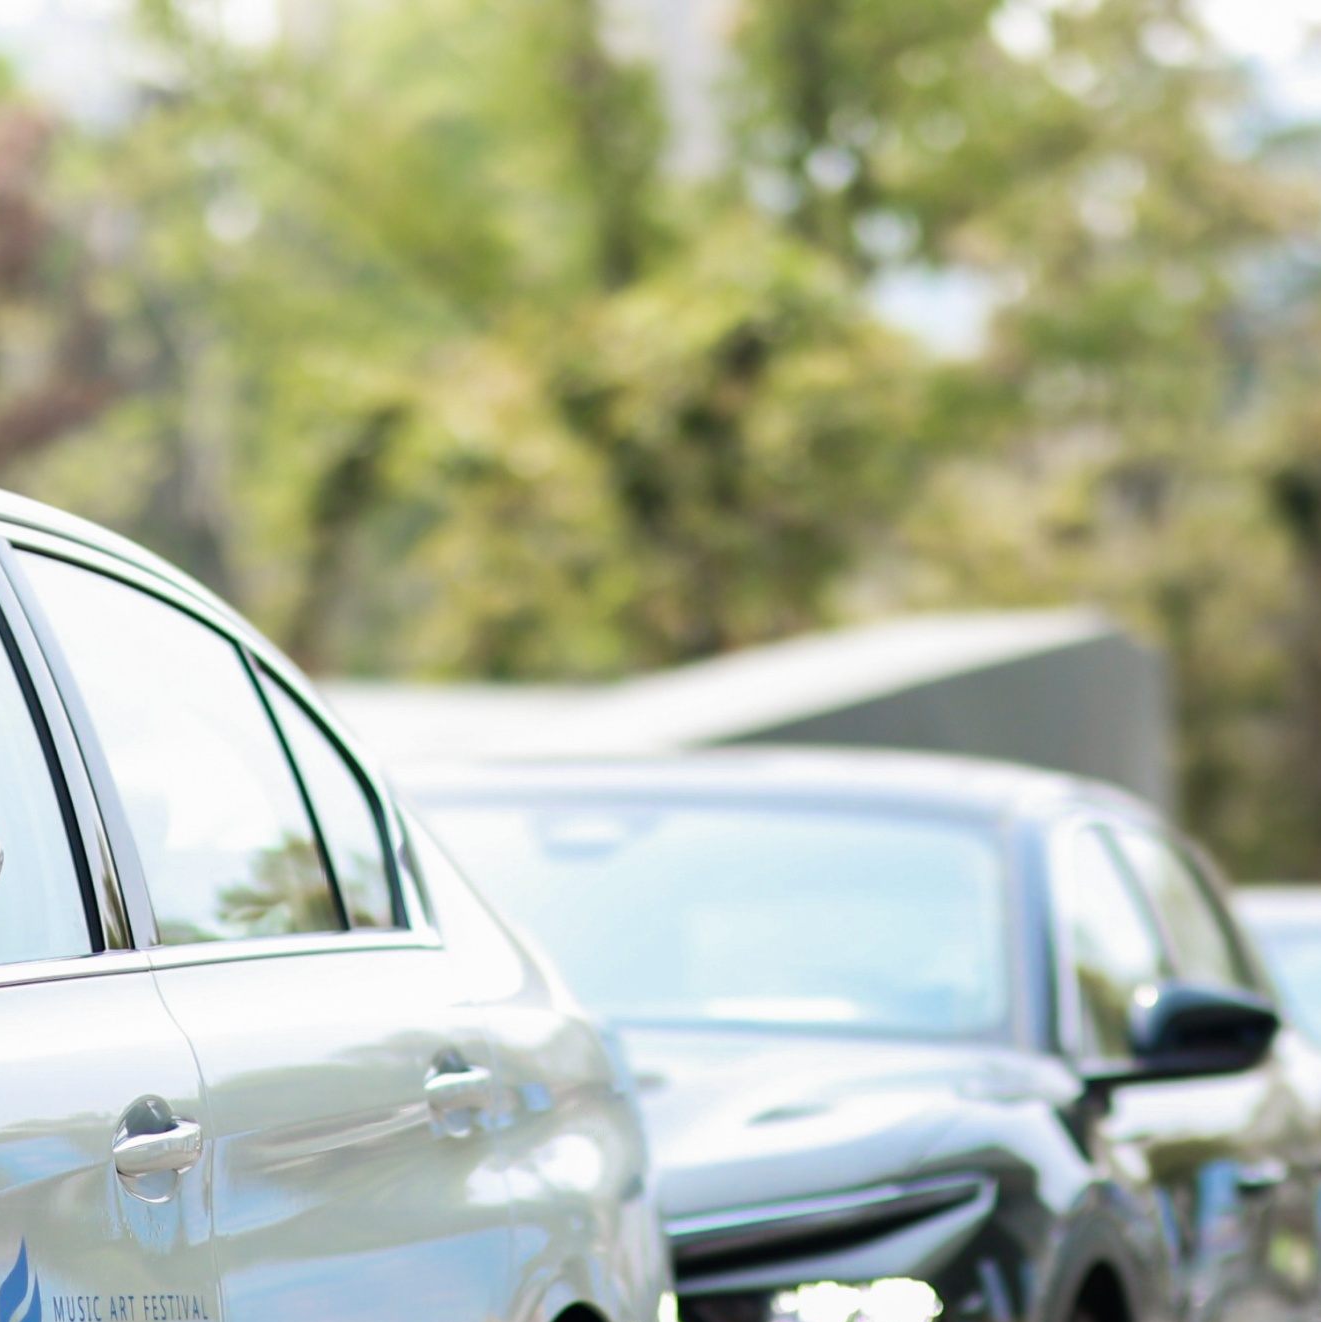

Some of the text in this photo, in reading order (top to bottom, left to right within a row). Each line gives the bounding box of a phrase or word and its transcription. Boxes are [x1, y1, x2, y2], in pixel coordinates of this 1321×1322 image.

[52, 1295, 209, 1322] MUSIC ART FESTIVAL
